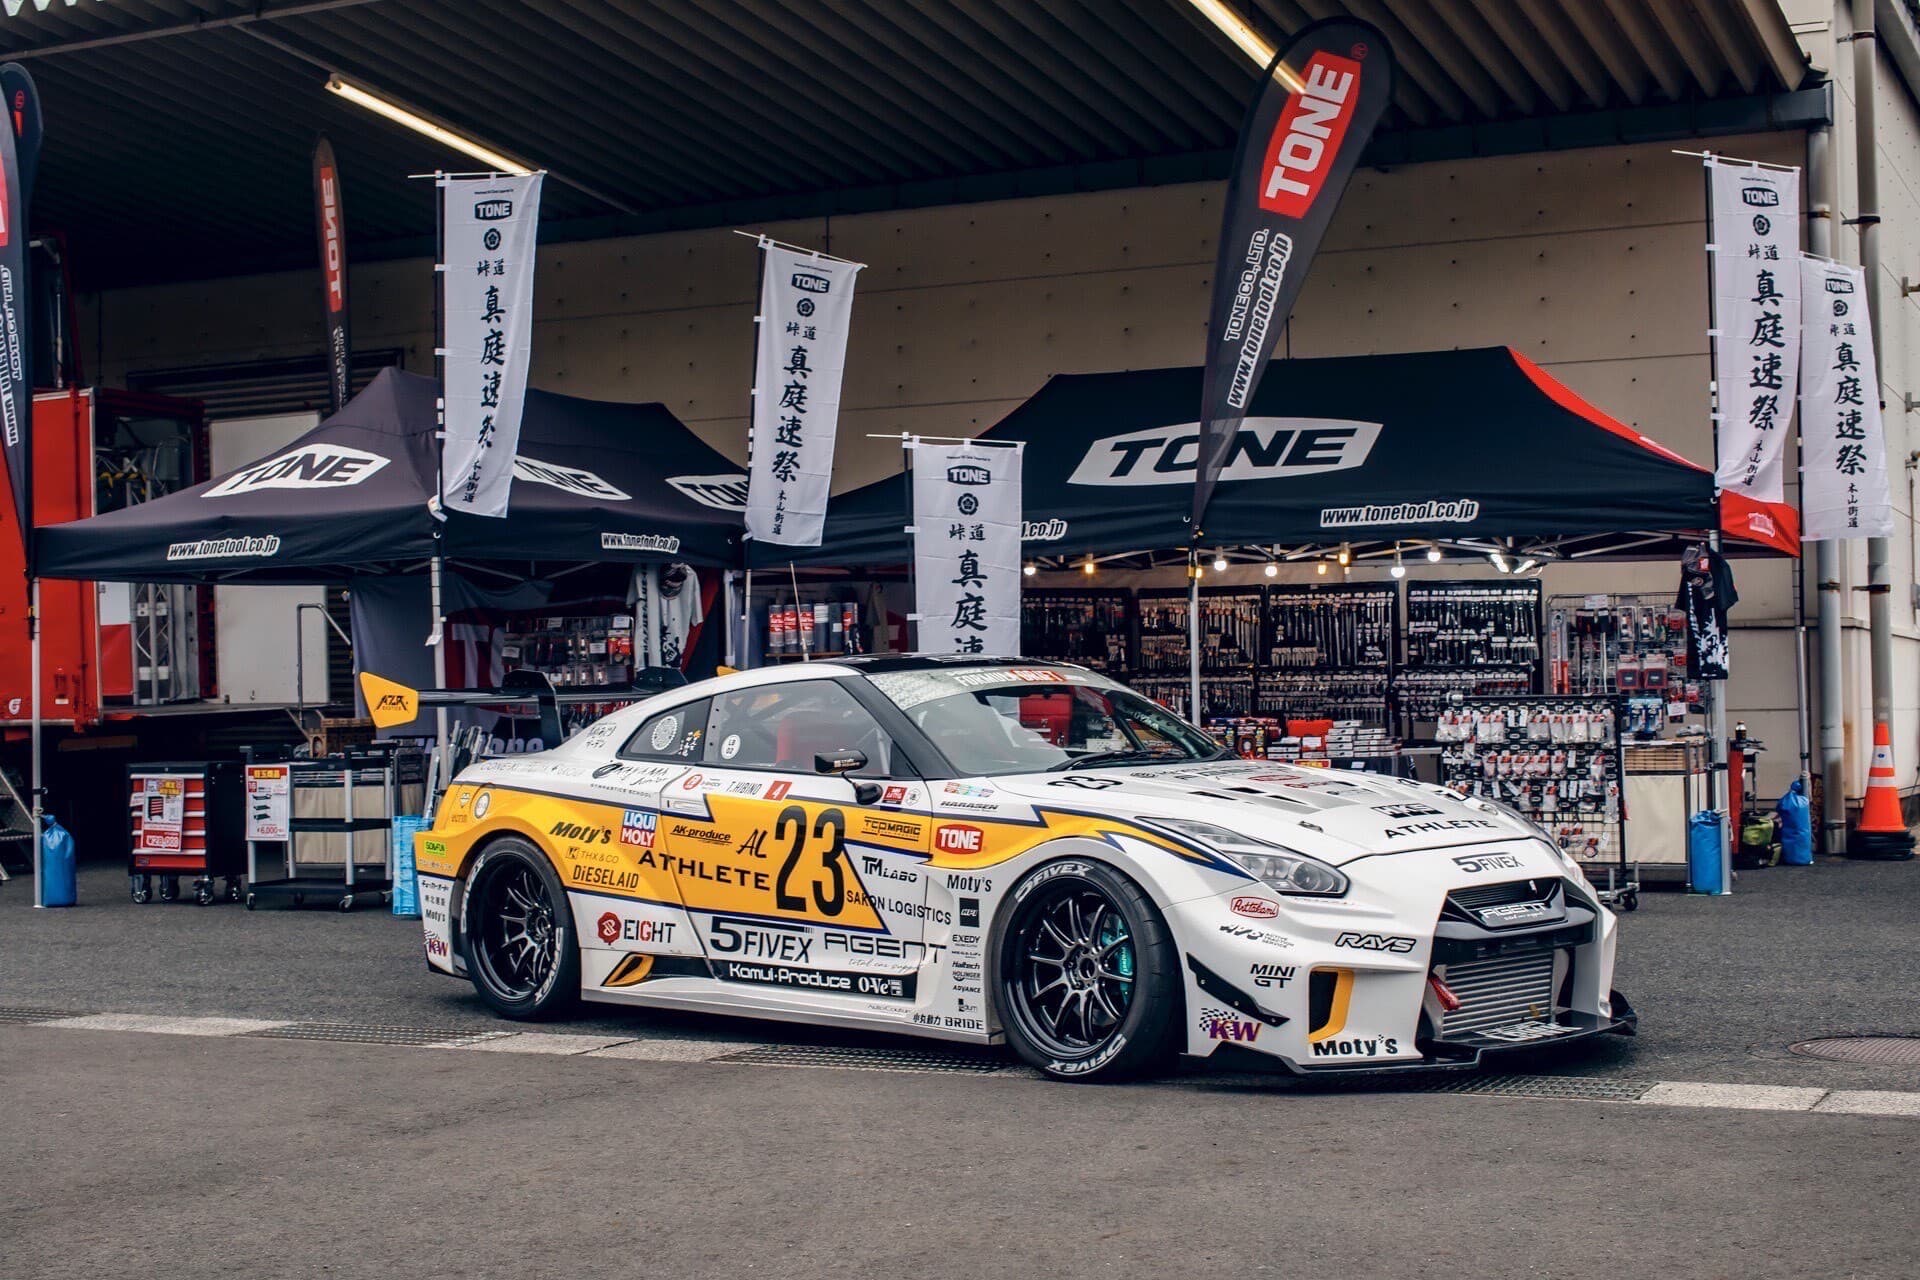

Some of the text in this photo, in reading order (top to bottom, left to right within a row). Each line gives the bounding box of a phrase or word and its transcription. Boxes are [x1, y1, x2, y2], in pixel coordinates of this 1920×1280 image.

[1265, 63, 1354, 199] TONE
[1744, 190, 1777, 205] TONE
[477, 203, 510, 217] TONE
[476, 258, 505, 277] 峠道
[795, 275, 827, 292] TONE
[786, 321, 817, 341] 峠道
[1227, 233, 1293, 409] www.tonetool.co.jp
[1749, 269, 1785, 431] 真庭速祭
[480, 284, 505, 449] 真庭速祭
[771, 345, 812, 483] 真庭速祭
[1832, 341, 1866, 476] 真庭速祭
[1109, 428, 1358, 478] TONE
[223, 452, 375, 491] TONE
[950, 468, 988, 483] TONE
[676, 480, 748, 505] TON
[1322, 502, 1475, 524] www.tonetool.co.jp
[949, 523, 985, 541] 峠道
[169, 535, 279, 558] www.tonetool.co.jp
[727, 781, 763, 796] T.HIBINO
[770, 784, 786, 798] 4
[624, 811, 656, 830] LIQUI
[1385, 820, 1498, 839] ATHLETE
[549, 821, 612, 844] Moty's
[621, 828, 655, 847] MOLY
[939, 828, 981, 850] TONE
[638, 850, 770, 891] ATHLETE
[775, 805, 846, 917] 23
[1452, 852, 1524, 873] 5FIVEX
[947, 874, 992, 893] Moty's
[846, 890, 952, 926] SAKON LOGISTICS
[624, 919, 676, 944] EIGHT
[710, 916, 813, 964] 5FIVEX
[952, 934, 981, 943] EXEDY
[1337, 933, 1416, 952] RAYS
[824, 932, 947, 963] AGENT
[1250, 964, 1296, 977] MINI
[1255, 978, 1285, 989] GT
[944, 1016, 984, 1030] BRIDE
[1209, 1018, 1263, 1042] KW
[1314, 1034, 1398, 1057] Moty's
